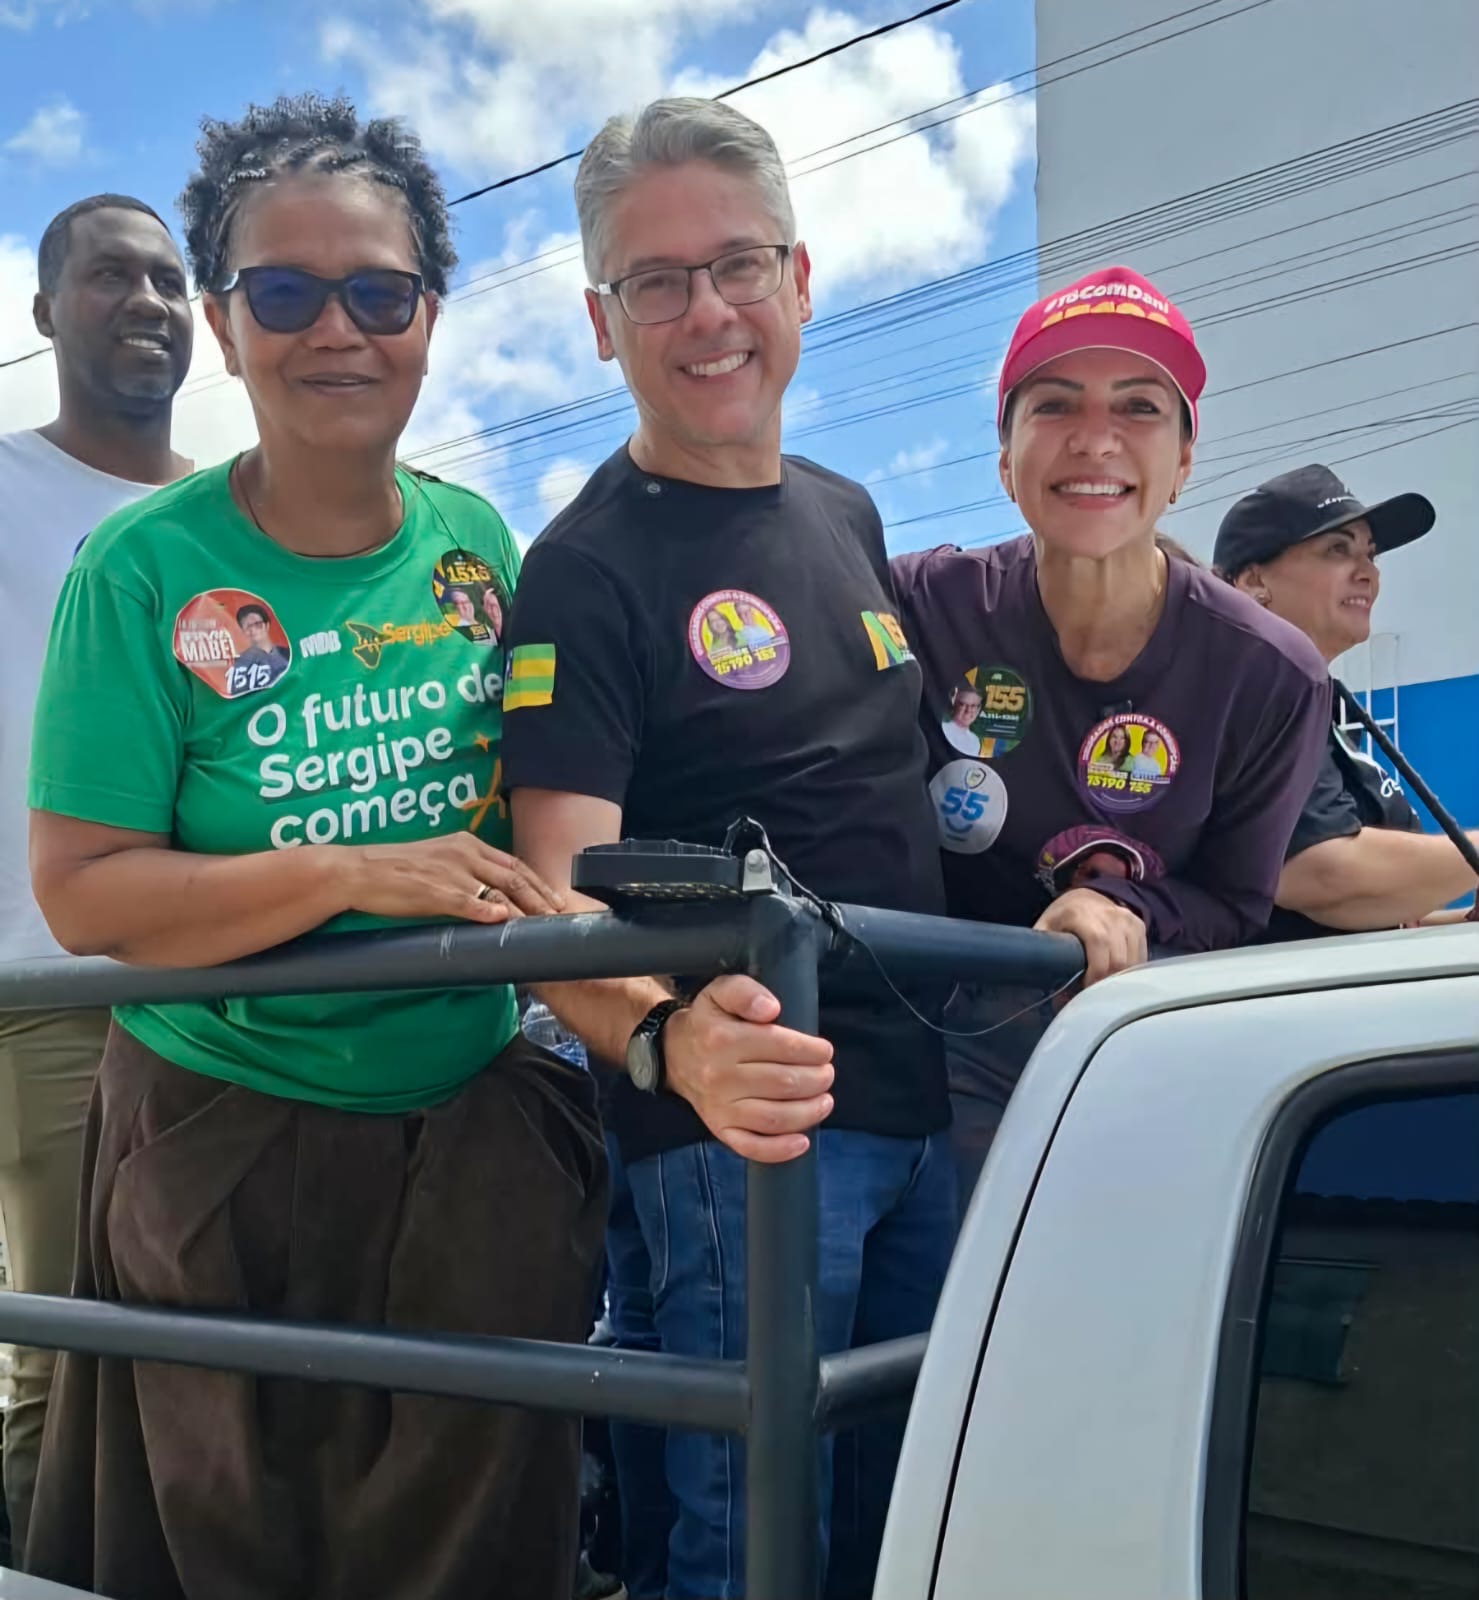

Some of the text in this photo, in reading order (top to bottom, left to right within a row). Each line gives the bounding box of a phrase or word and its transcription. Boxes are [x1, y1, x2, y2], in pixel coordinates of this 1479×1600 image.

[446, 563, 491, 583] 1515
[224, 663, 271, 694] 1515
[247, 663, 503, 748] O futuro de
[984, 685, 1026, 712] 155
[258, 727, 454, 798] Sergipe
[270, 772, 479, 849] começa
[940, 786, 989, 821] 55
